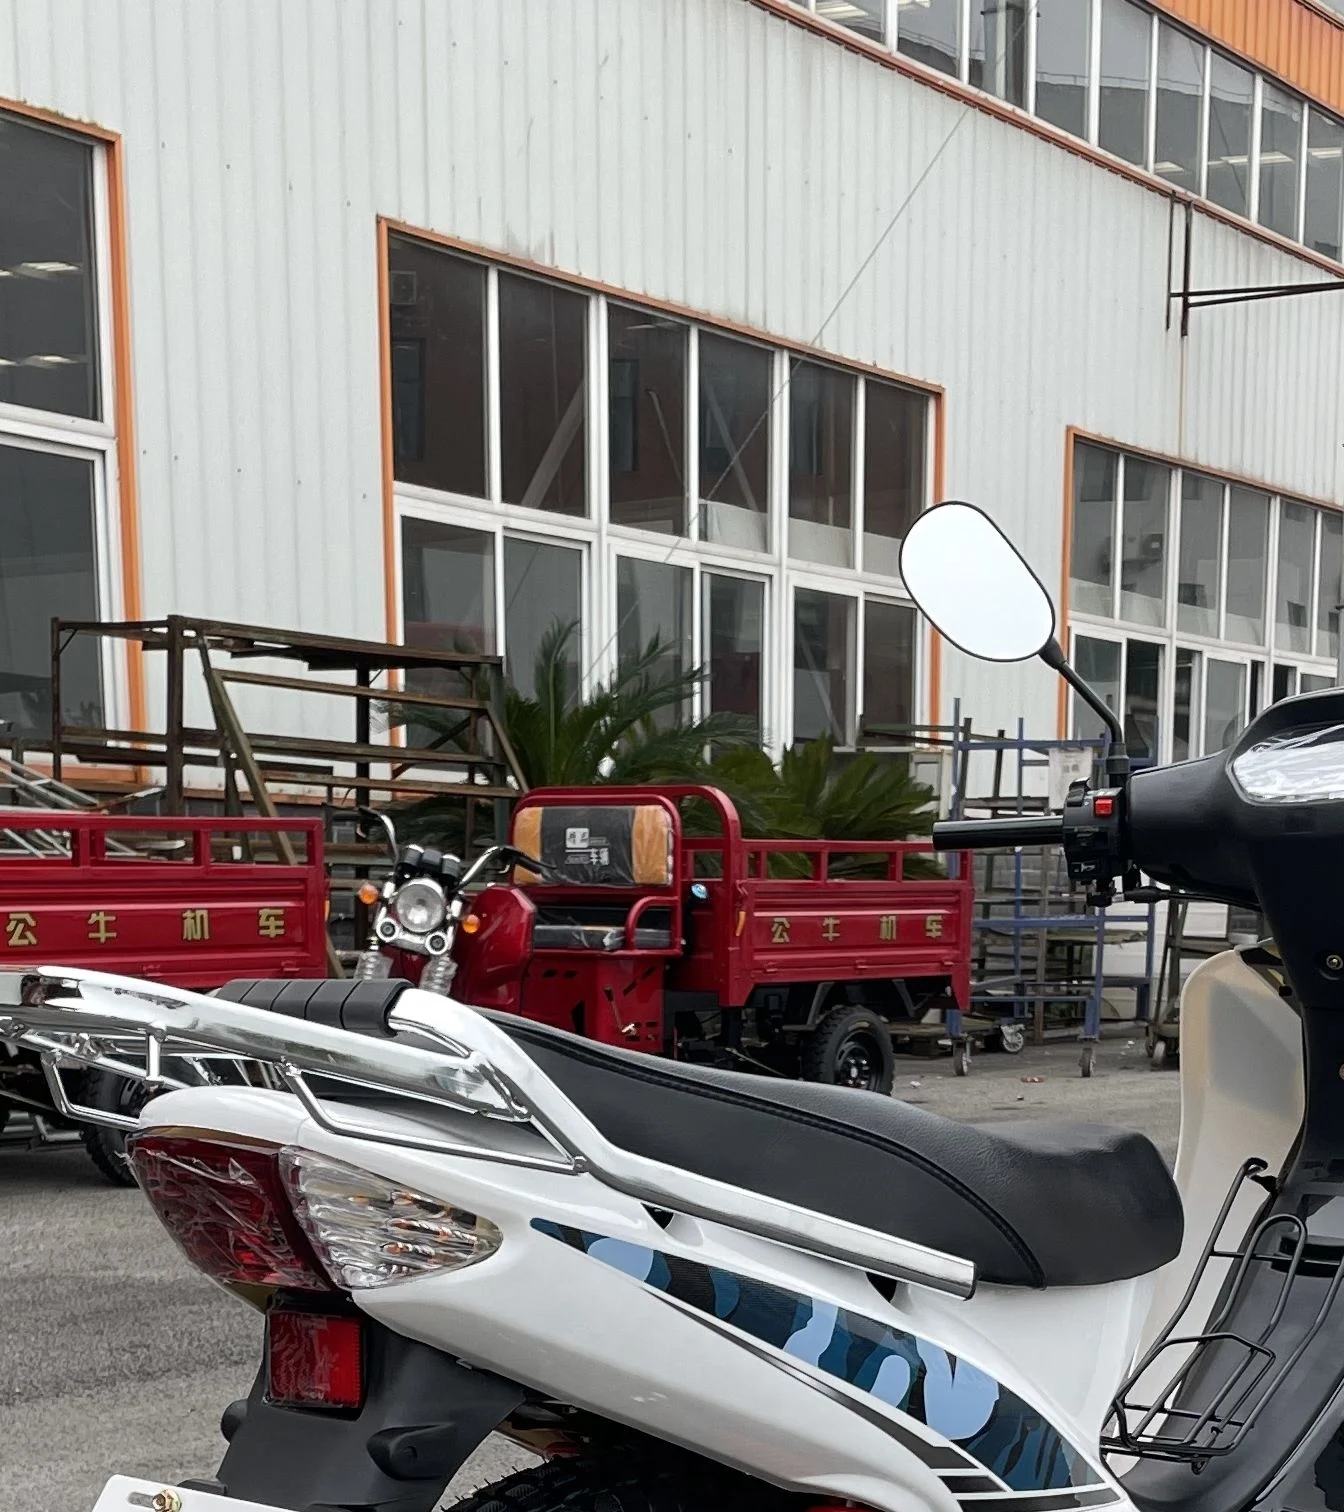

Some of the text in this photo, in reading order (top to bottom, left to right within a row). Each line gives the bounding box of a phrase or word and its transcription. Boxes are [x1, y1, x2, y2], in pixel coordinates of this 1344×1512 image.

[6, 908, 285, 946] 公牛机车
[771, 915, 942, 943] 公牛机车
